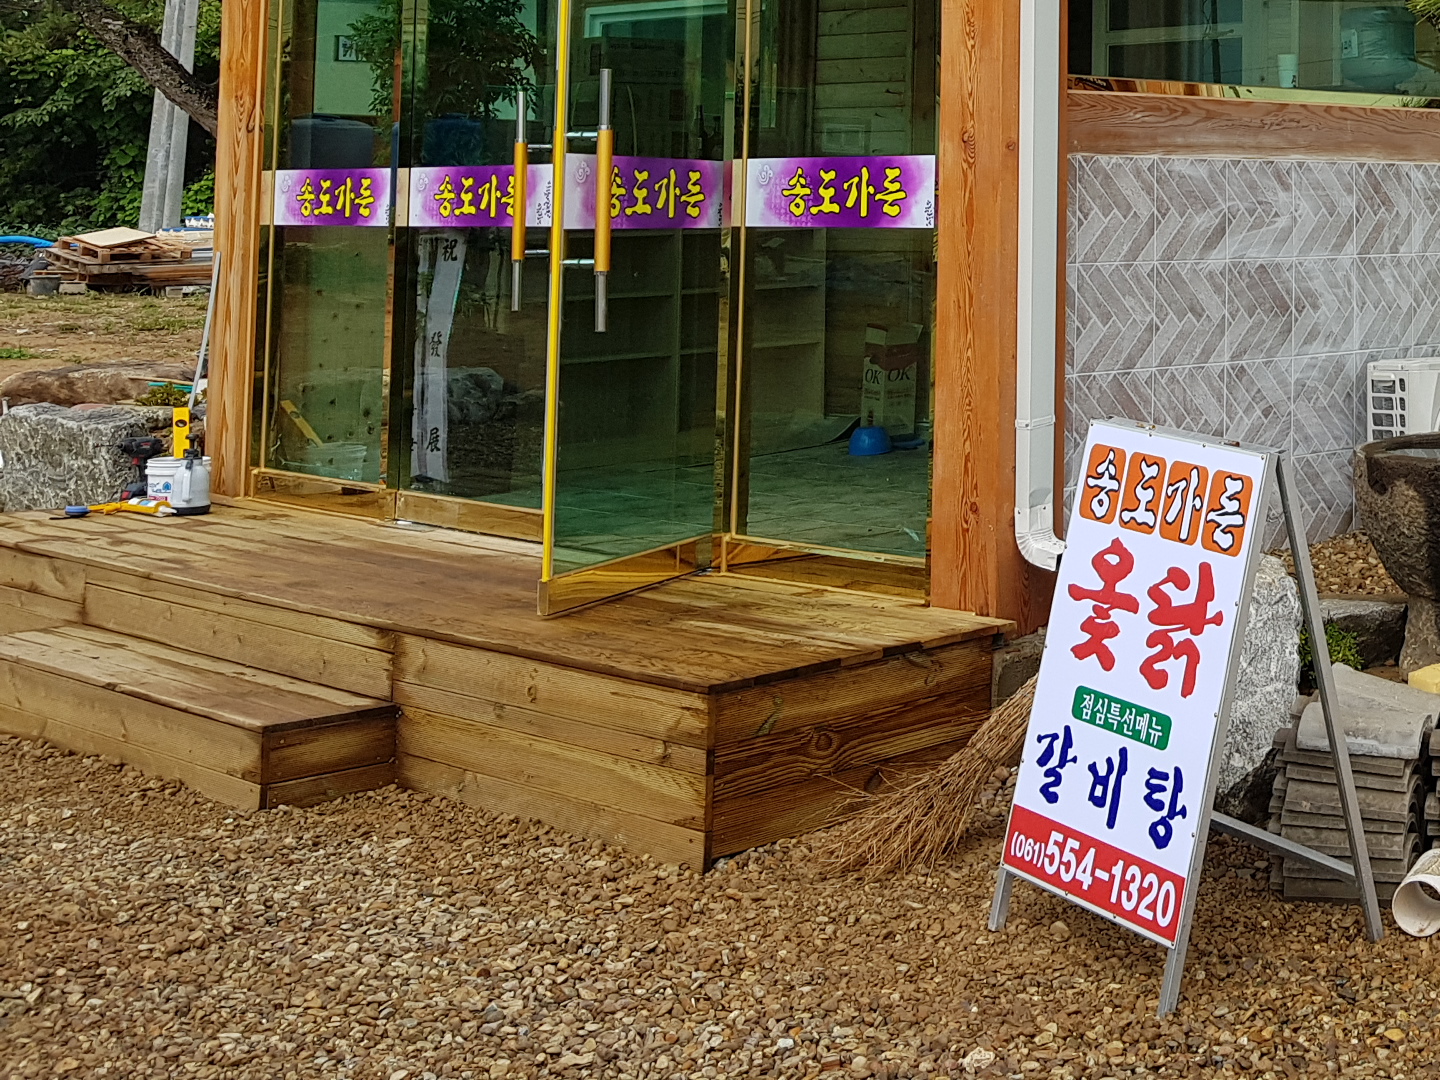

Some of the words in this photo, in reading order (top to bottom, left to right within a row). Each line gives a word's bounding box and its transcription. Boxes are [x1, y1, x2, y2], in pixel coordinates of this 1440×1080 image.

[296, 176, 376, 218] 송도가든
[782, 166, 907, 218] 송도가든
[865, 368, 881, 385] OK
[1086, 450, 1246, 551] 송도가든
[1080, 694, 1164, 746] 점심특선메뉴
[1036, 724, 1187, 850] 갈비탕
